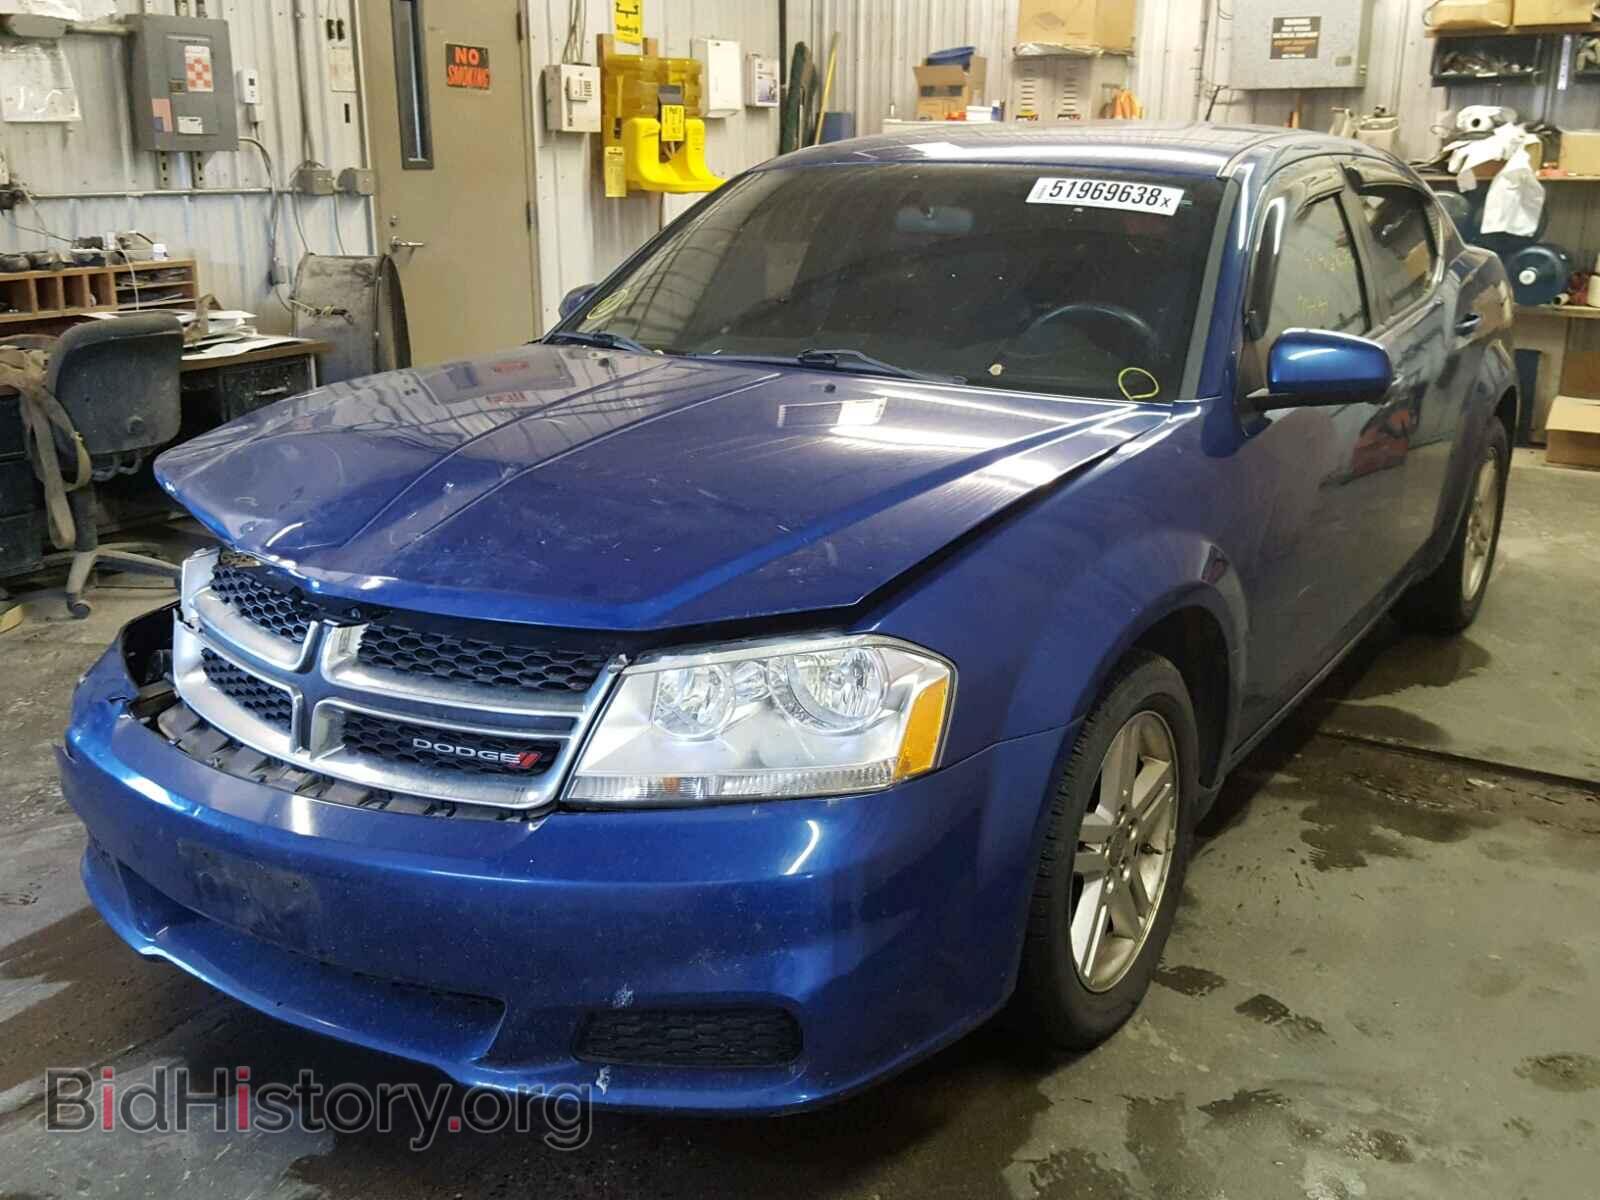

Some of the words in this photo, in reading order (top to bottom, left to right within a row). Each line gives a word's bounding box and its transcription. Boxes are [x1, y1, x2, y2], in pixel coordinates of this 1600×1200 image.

[455, 47, 480, 65] NO
[448, 65, 489, 88] SMOKING
[413, 738, 521, 763] DODGE
